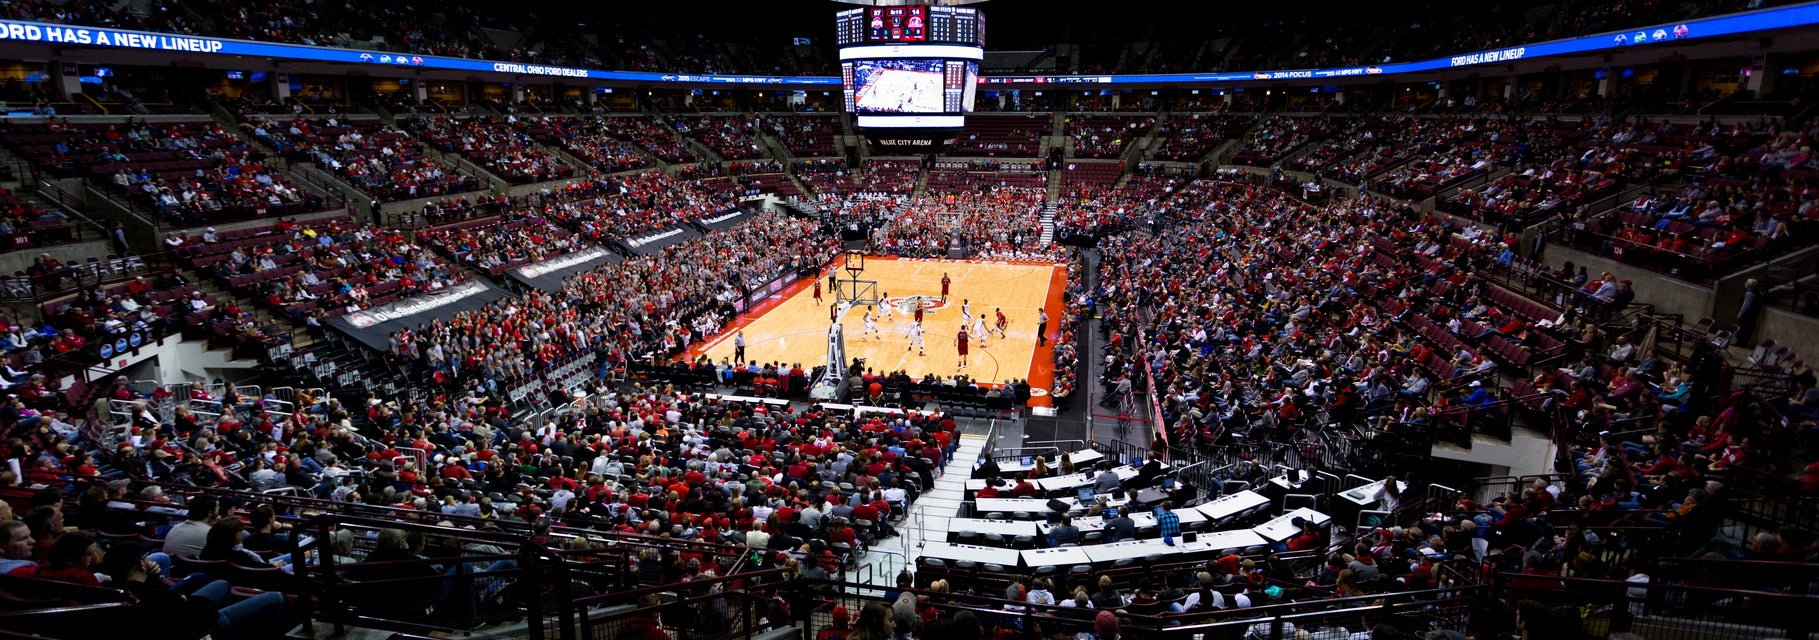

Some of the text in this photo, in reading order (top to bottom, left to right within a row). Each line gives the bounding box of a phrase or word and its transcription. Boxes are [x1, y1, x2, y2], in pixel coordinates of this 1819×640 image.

[45, 27, 92, 44] HAS
[96, 31, 111, 46] A
[113, 32, 157, 48] NEW
[161, 36, 223, 52] LINEUP
[1450, 48, 1525, 66] FORD HAS A NEW LINEUP
[494, 62, 588, 78] CENTRAL OHIO FORD DEALERS
